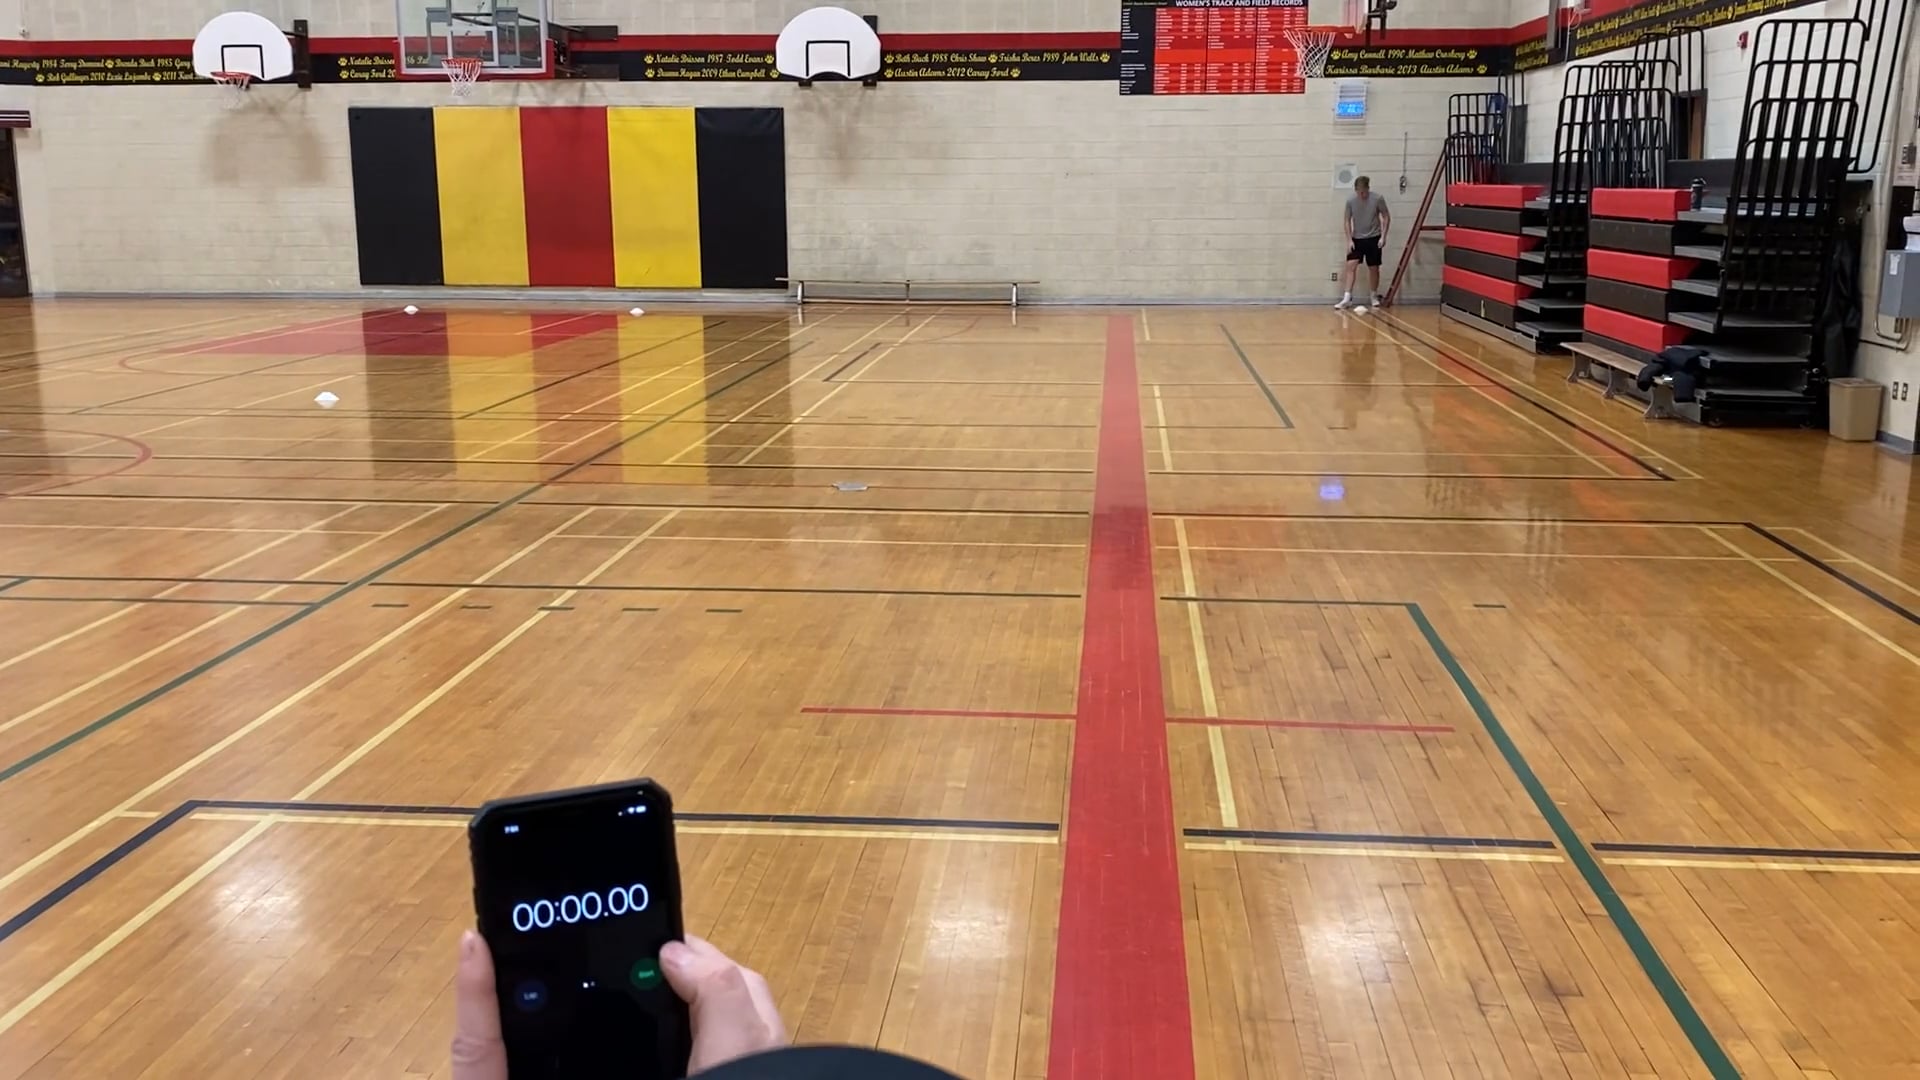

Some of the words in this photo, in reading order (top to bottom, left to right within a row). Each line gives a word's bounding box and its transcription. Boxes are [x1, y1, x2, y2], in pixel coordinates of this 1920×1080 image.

[894, 68, 918, 77] Austin
[919, 68, 945, 77] Adams
[946, 67, 966, 77] 2012
[1397, 64, 1418, 74] 2013
[1420, 64, 1446, 74] Austin
[1446, 64, 1474, 74] Adams
[512, 883, 649, 932] 00:00.00
